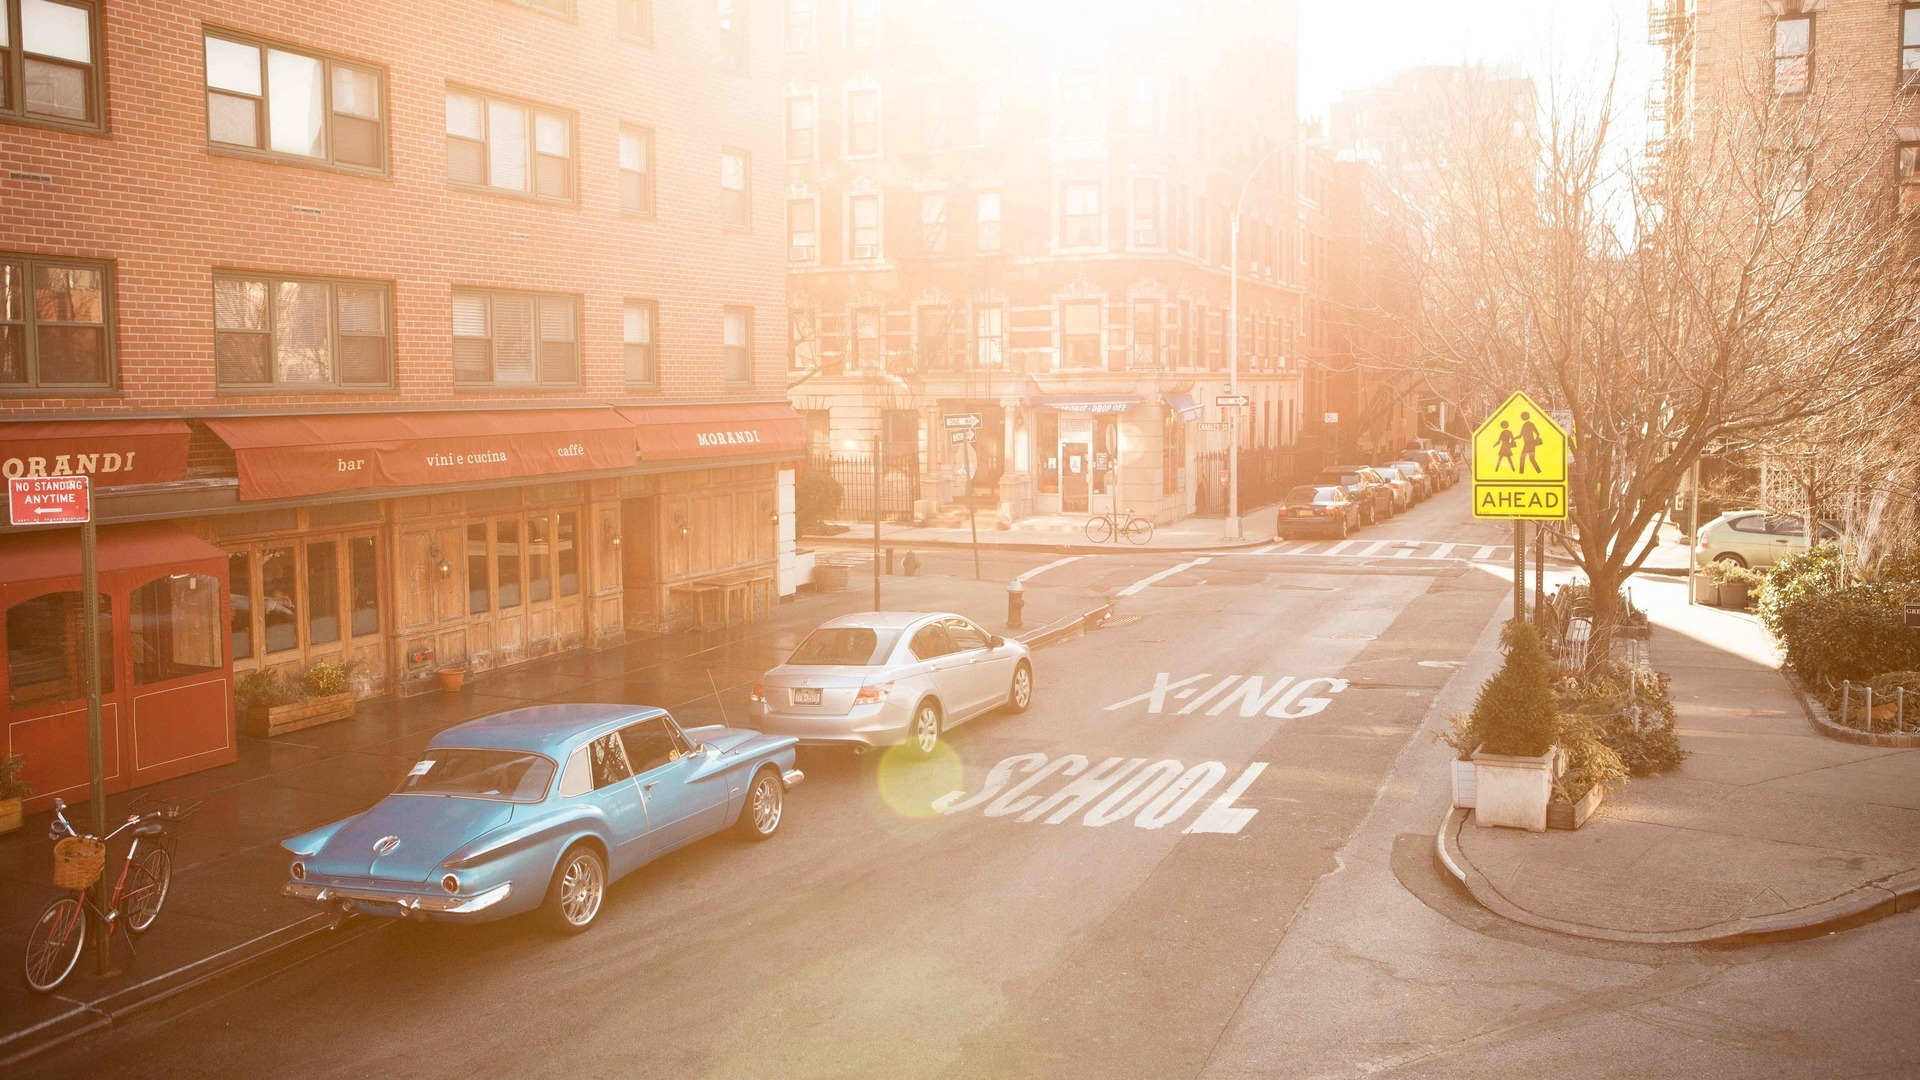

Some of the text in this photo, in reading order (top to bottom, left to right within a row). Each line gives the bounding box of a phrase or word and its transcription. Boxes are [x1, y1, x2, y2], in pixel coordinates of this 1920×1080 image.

[1091, 404, 1112, 412] DROP
[1112, 404, 1127, 412] OFF
[697, 430, 761, 446] MORANDI
[426, 450, 507, 468] vini e cucina
[557, 443, 584, 459] caffè
[337, 457, 365, 473] bar
[15, 480, 83, 492] NO STANDING
[24, 493, 76, 504] ANYTIME
[1481, 491, 1559, 508] AHEAD
[932, 752, 1270, 835] SCHOOL
